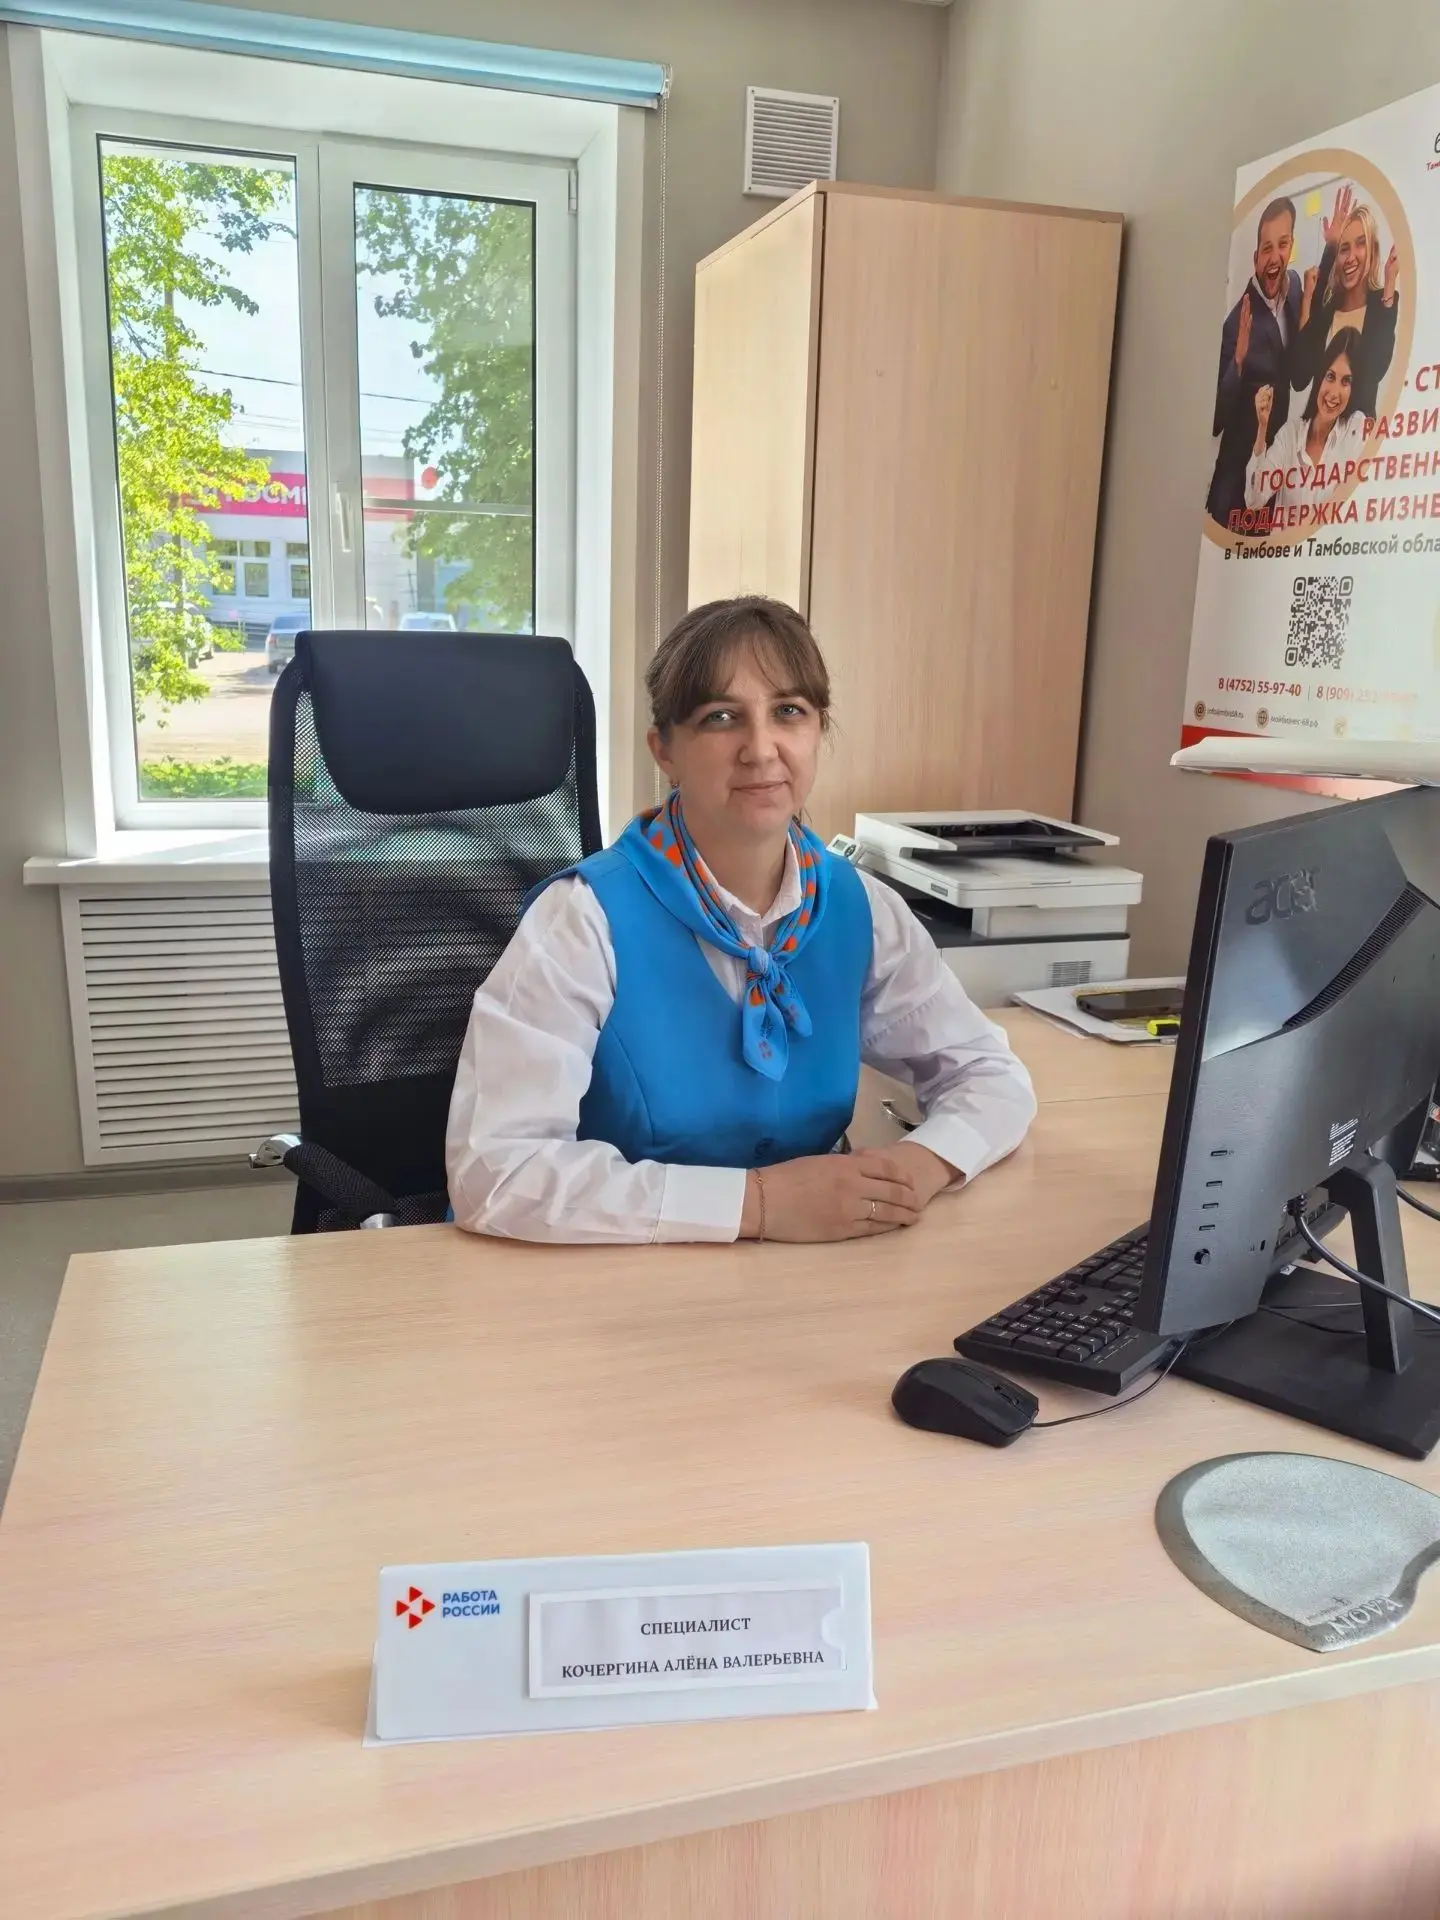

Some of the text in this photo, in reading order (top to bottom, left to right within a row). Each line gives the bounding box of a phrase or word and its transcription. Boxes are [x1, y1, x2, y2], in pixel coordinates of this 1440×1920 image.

[1228, 500, 1358, 532] ПОДДЕРЖКА
[1224, 549, 1231, 560] в
[1235, 541, 1290, 560] Тамбове
[1294, 545, 1302, 558] и
[1307, 534, 1398, 557] Тамбовской
[1218, 678, 1301, 697] 8 (4752) 55-97-40
[1316, 686, 1324, 699] 8
[1244, 866, 1320, 926] acer
[442, 1590, 498, 1604] РАБОТА
[442, 1604, 500, 1618] РОССИИ
[640, 1617, 751, 1636] СПЕЦИАЛИСТ
[561, 1650, 825, 1679] КОЧЕРГИНА АЛЁНА ВАЛЕРЬЕВНА
